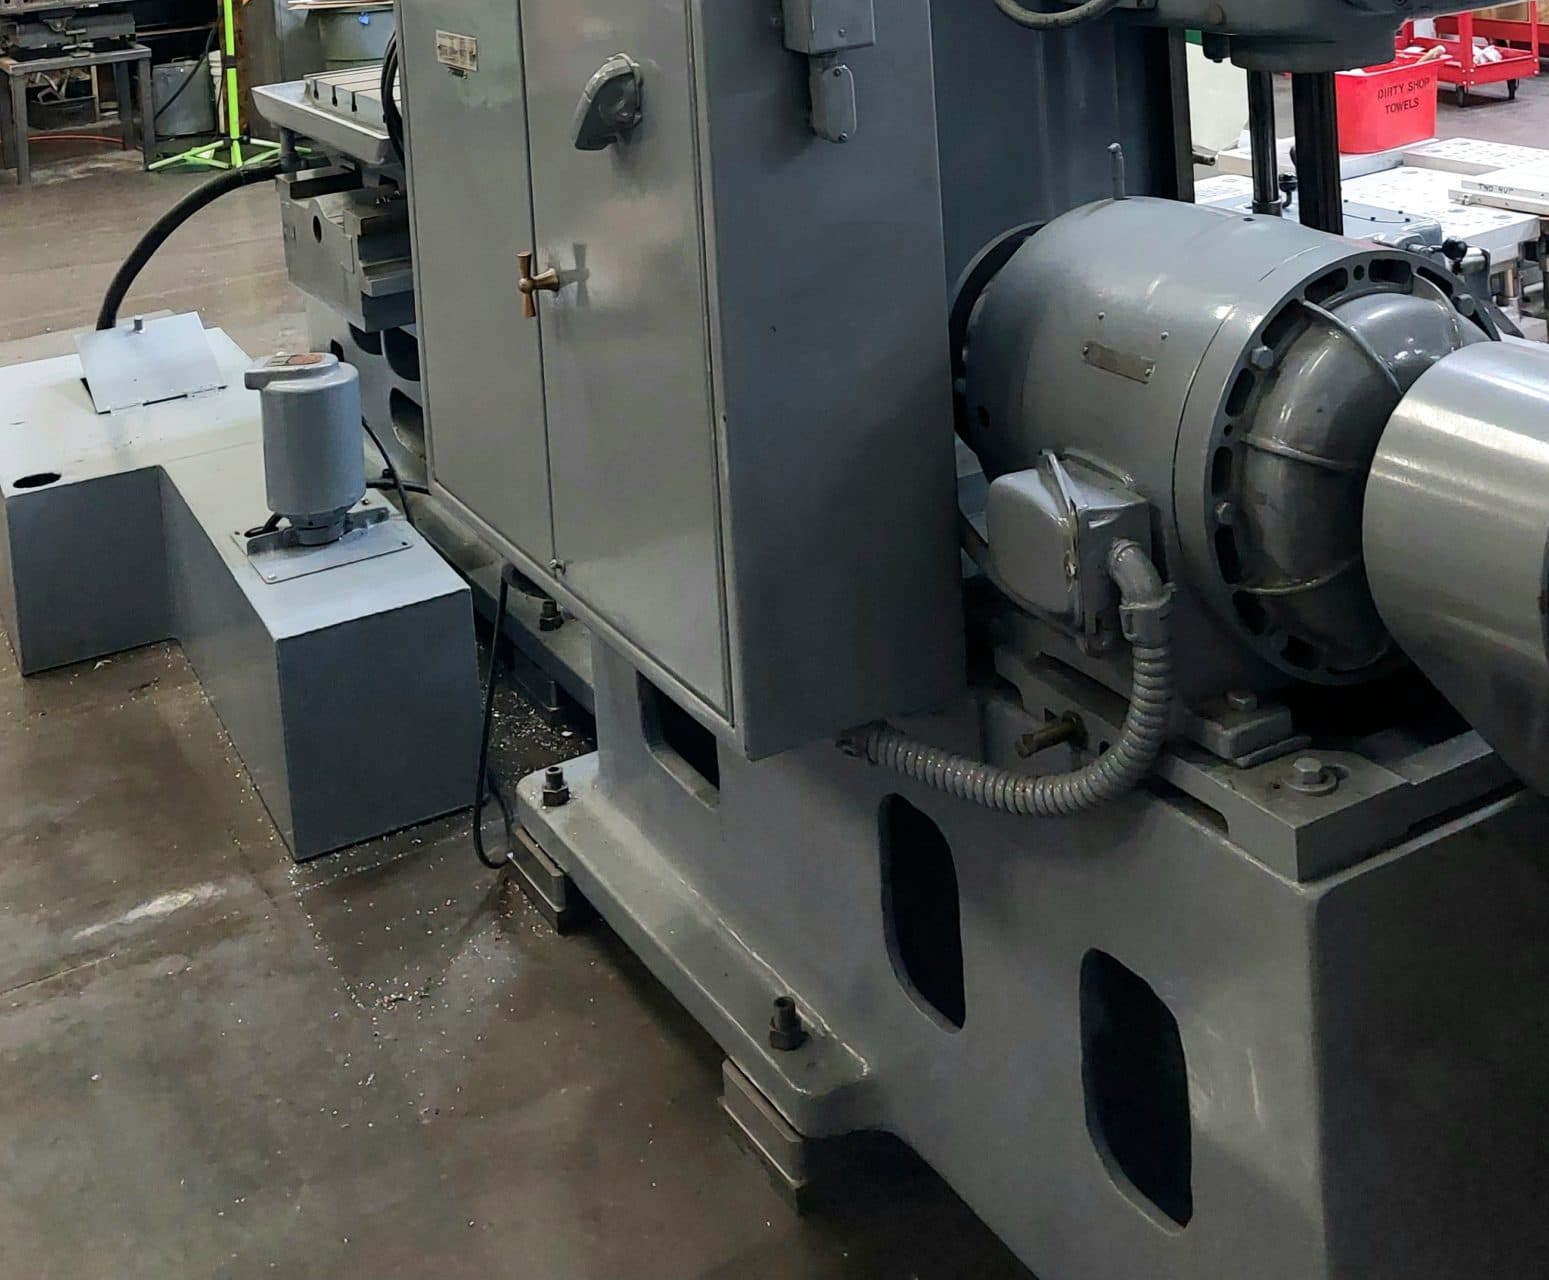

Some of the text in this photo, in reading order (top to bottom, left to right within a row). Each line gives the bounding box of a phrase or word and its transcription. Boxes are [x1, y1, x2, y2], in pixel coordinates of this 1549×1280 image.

[1377, 77, 1430, 100] DIRTY SHOP
[1385, 97, 1419, 114] TOWELS
